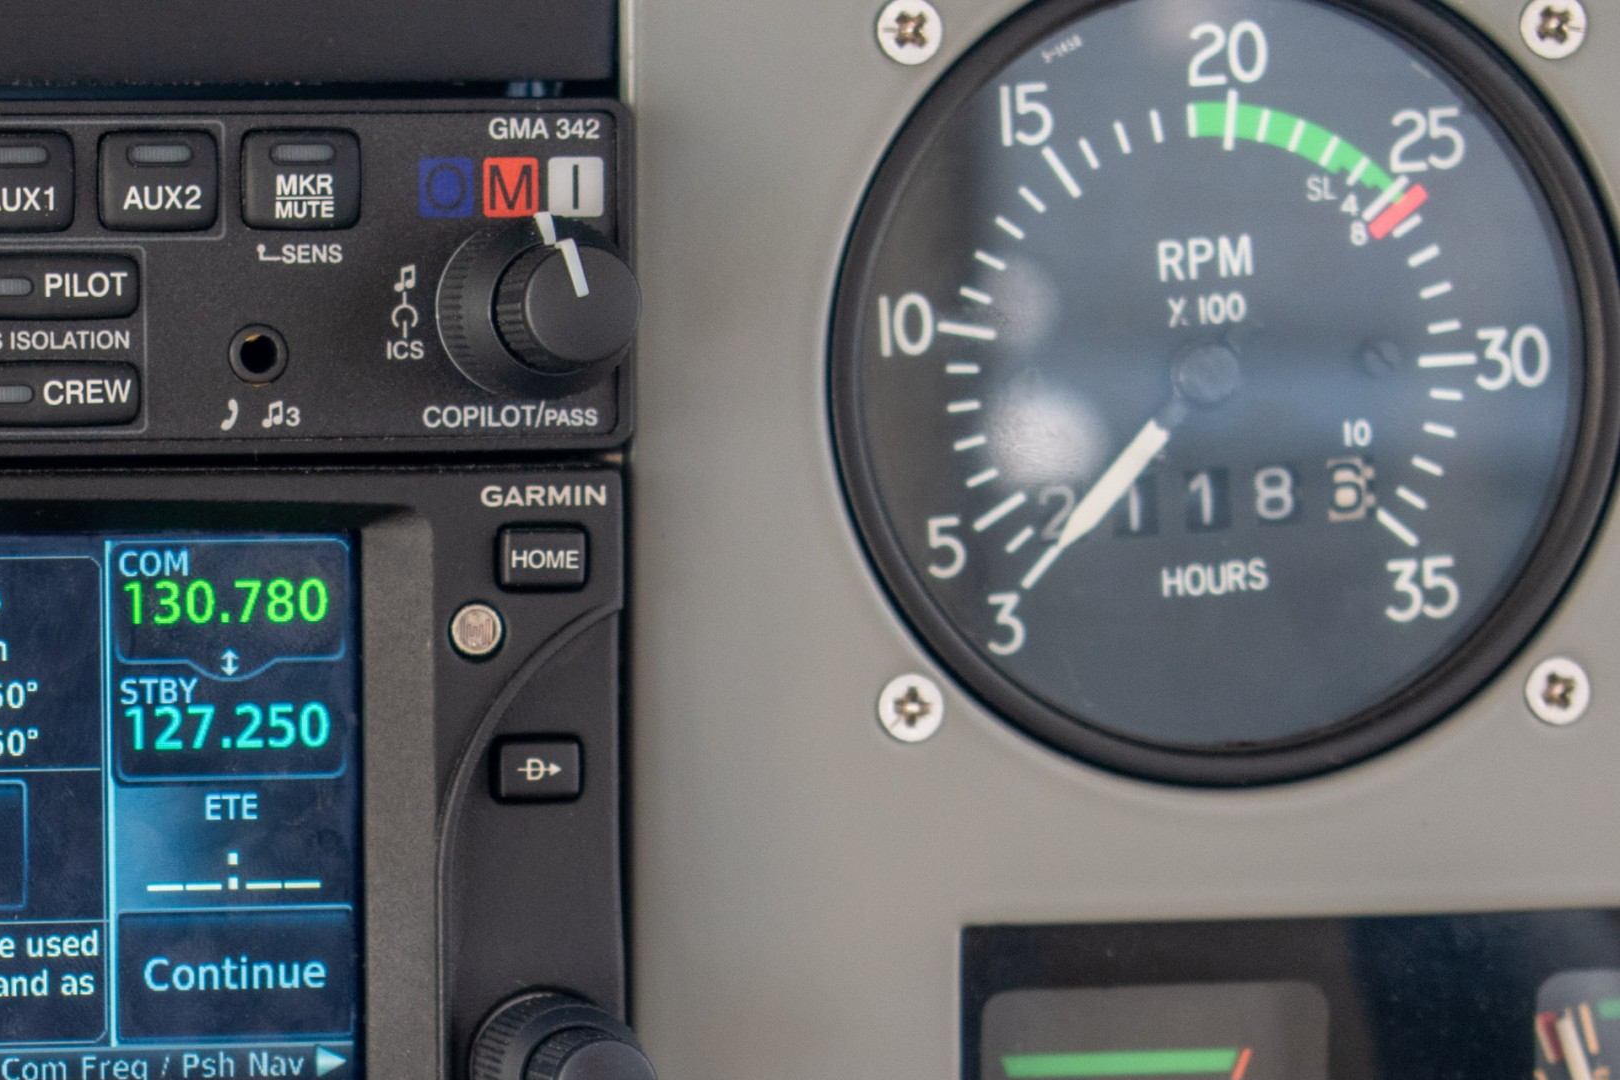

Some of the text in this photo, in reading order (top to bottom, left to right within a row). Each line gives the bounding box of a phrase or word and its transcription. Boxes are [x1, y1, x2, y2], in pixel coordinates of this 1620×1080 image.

[1189, 21, 1268, 86] 20
[1000, 82, 1053, 147] 15
[488, 118, 600, 140] GMA 342
[1390, 106, 1465, 173] 25
[123, 186, 202, 212] AUX2
[276, 175, 333, 196] MKR
[1307, 176, 1338, 202] SL
[276, 200, 334, 218] MUTE
[282, 244, 342, 264] SENS
[1158, 235, 1253, 281] RPM
[45, 272, 127, 297] PILOT
[879, 293, 934, 357] 10
[11, 331, 129, 349] ISOLATION
[386, 342, 424, 360] ICS
[1476, 326, 1550, 389] 30
[43, 380, 131, 404] CREW
[423, 406, 598, 428] COPILOT/PASS
[481, 486, 606, 506] GARMIN
[511, 550, 579, 570] HOME
[928, 516, 966, 578] 5
[118, 551, 189, 577] COM
[1162, 558, 1268, 597] HOURS
[123, 578, 328, 625] 130.780
[1386, 556, 1459, 620] 35
[988, 592, 1025, 654] 3
[120, 678, 197, 705] STBY
[125, 703, 329, 751] 127.250
[205, 794, 258, 820] ETE
[26, 929, 99, 957] used
[144, 956, 325, 993] Continue
[183, 1054, 235, 1079] Psh
[249, 1052, 304, 1078] Nav
